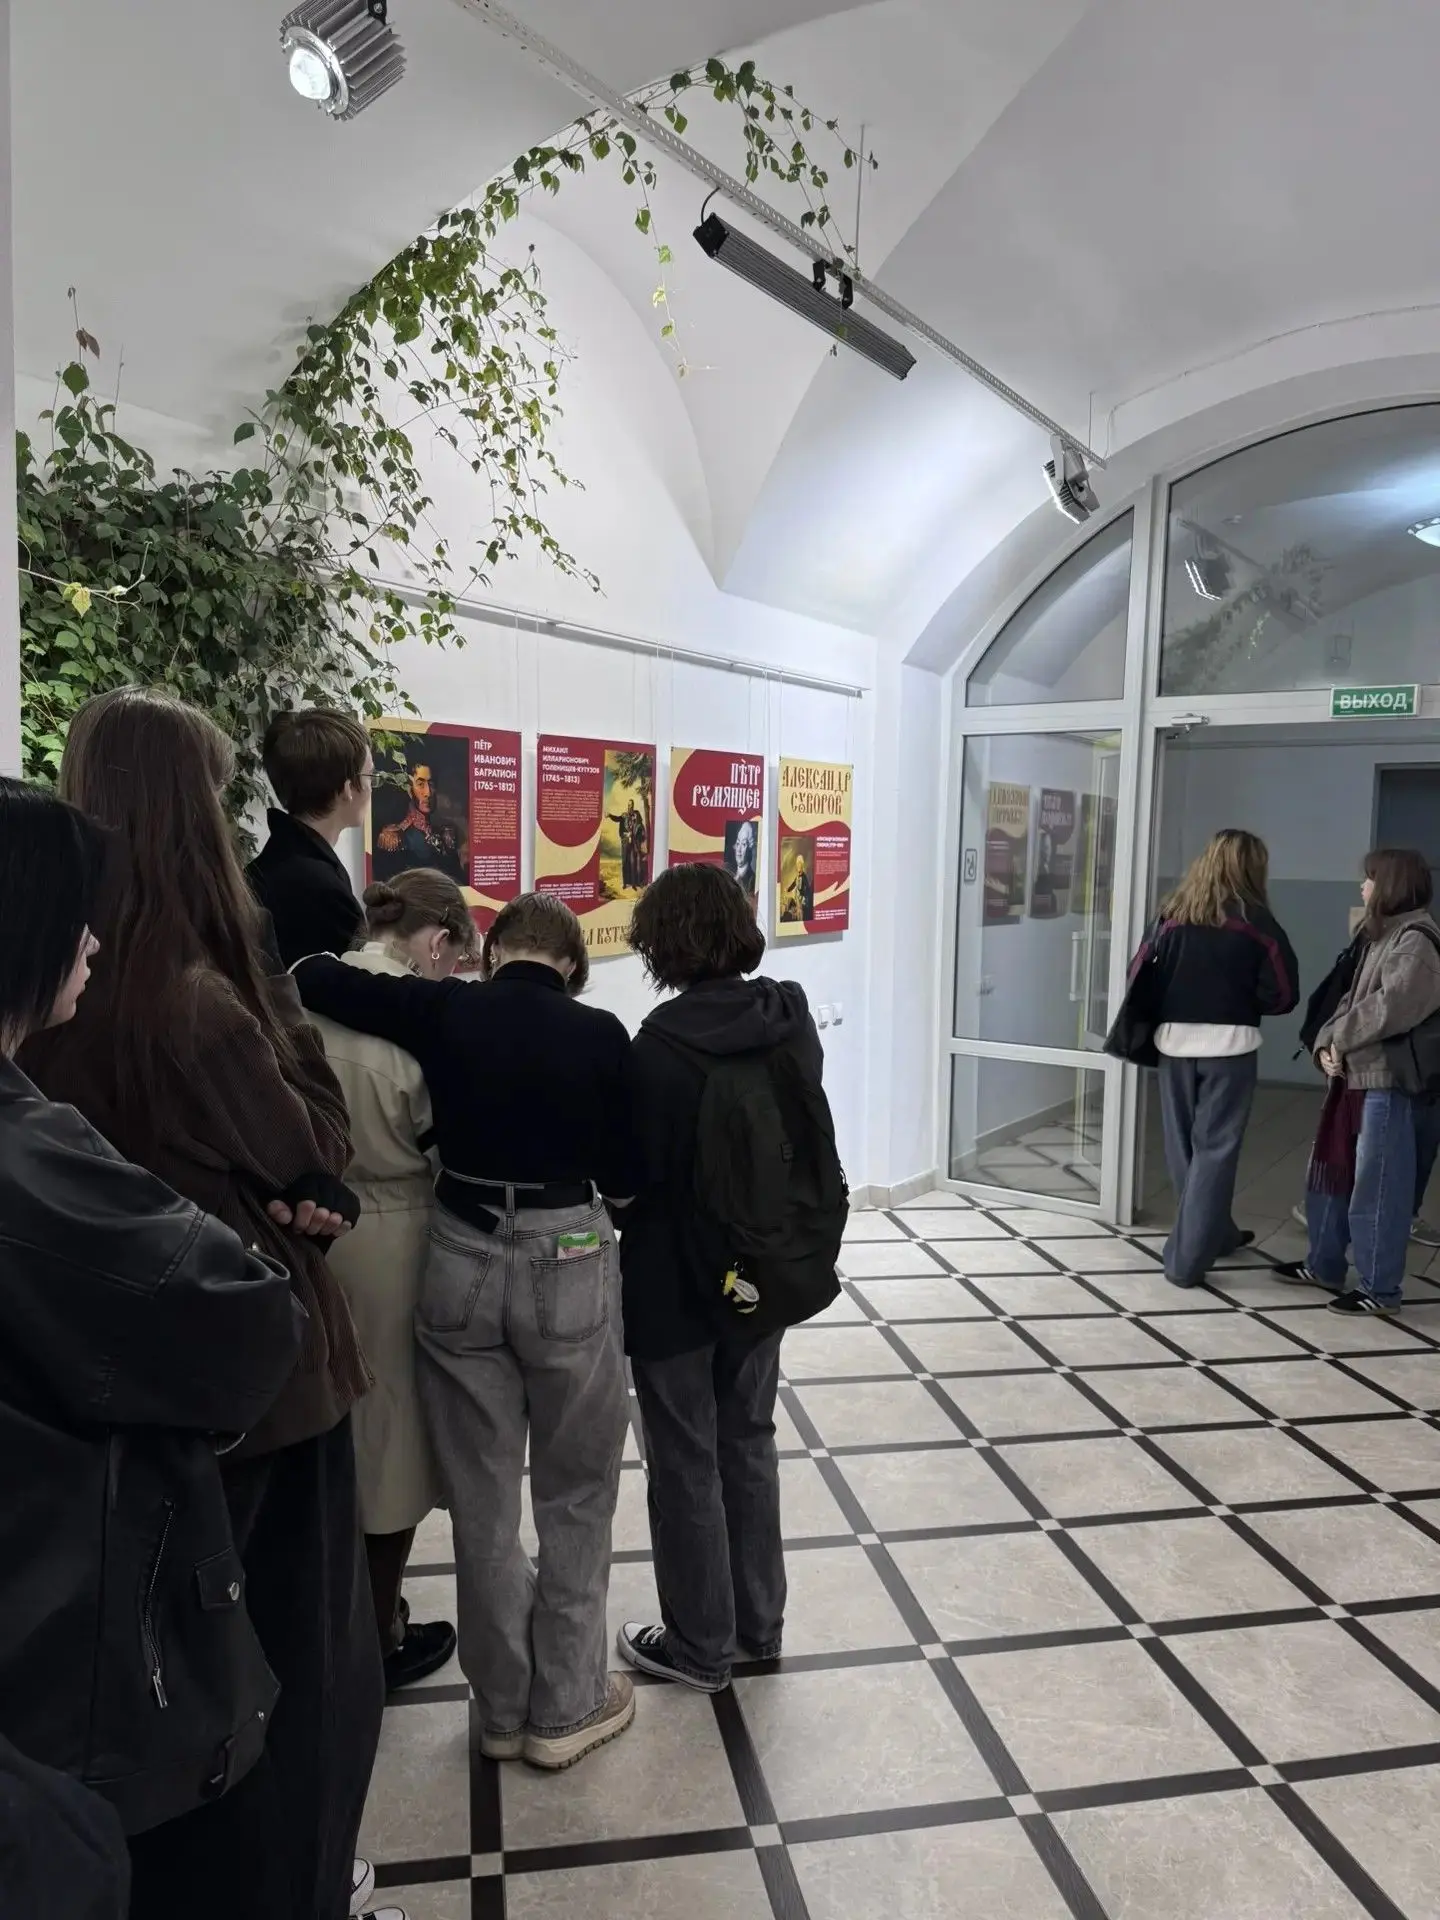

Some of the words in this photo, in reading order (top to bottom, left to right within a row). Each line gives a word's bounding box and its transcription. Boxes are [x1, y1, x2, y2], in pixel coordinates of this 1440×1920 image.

[1340, 692, 1407, 710] ВЫХОД
[474, 754, 517, 766] ИВАНОВИЧ
[474, 768, 517, 779] БАГРАТИОН
[782, 765, 852, 793] АЛЕКСАНДР
[691, 784, 760, 816] РУМЯНЦЕВ
[790, 791, 842, 816] СУВОРОВ
